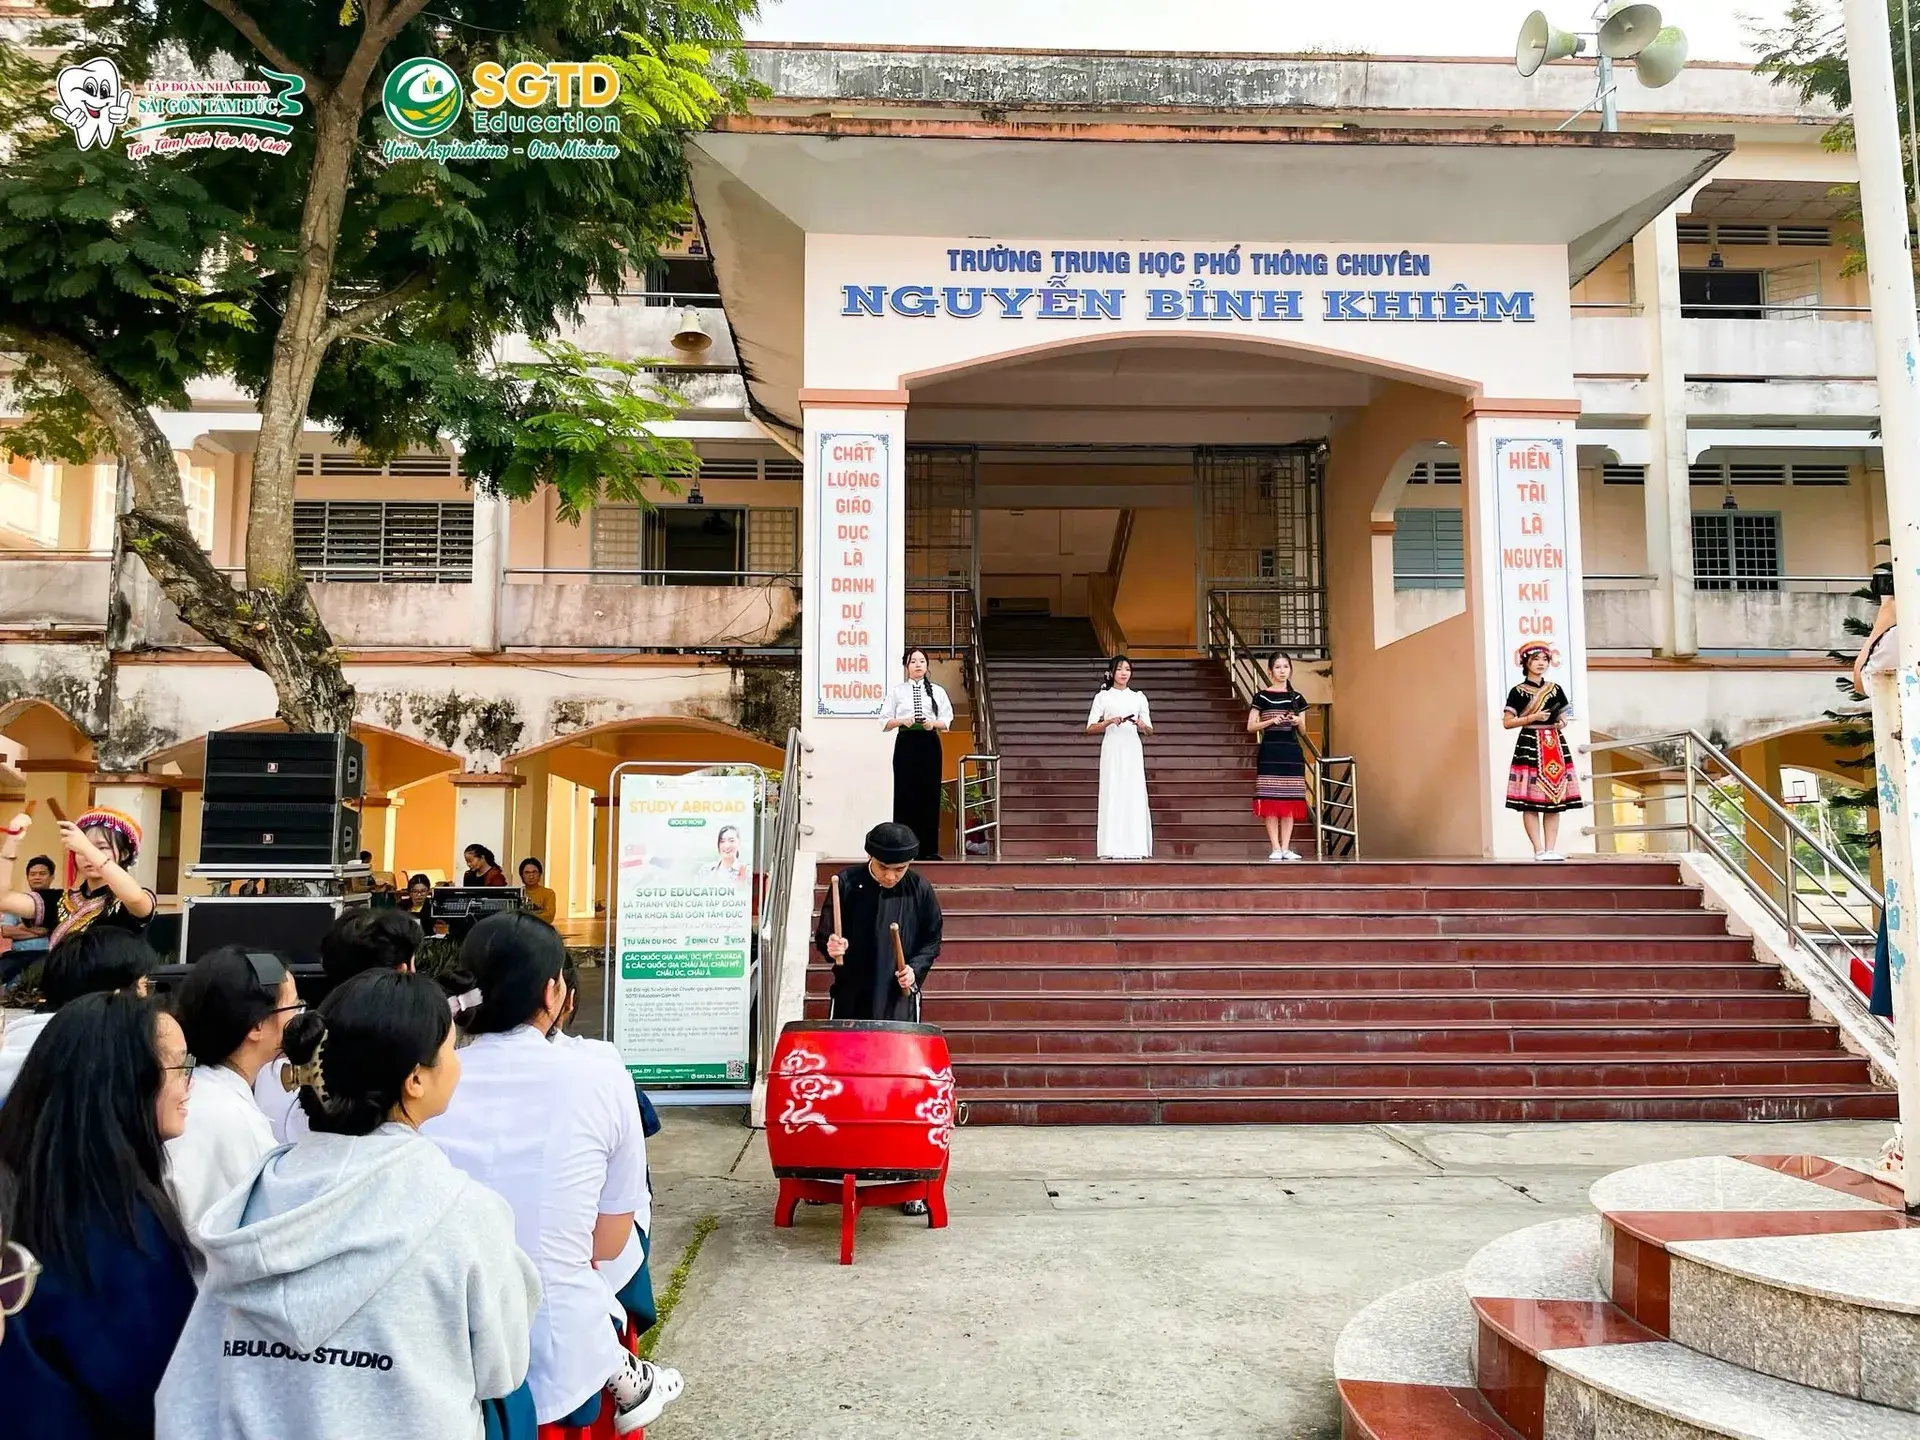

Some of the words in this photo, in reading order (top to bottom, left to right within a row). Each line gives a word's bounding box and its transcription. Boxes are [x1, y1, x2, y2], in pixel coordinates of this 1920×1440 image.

[947, 244, 1041, 272] TRƯỜNG
[1051, 250, 1130, 274] TRUNG
[1139, 251, 1185, 278] HỌC
[1250, 249, 1328, 276] THÔNG
[1336, 250, 1430, 276] CHUYÊN
[841, 275, 1126, 319] NGUYỄN
[1146, 279, 1304, 321] BỈNH
[1323, 283, 1535, 322] KHIÊM
[833, 441, 875, 462] CHẤT
[1509, 444, 1550, 469] HIỀN
[827, 470, 880, 491] LƯỢNG
[1517, 480, 1546, 502] TÀI
[835, 495, 872, 514] GIÁO
[837, 525, 869, 543] DỤC
[1521, 513, 1543, 534] LÀ
[843, 547, 863, 566] LÀ
[1503, 543, 1563, 569] NGUYÊN
[831, 578, 875, 593] DANH
[1518, 579, 1550, 602] KHÍ
[842, 602, 864, 622] DỰ
[1518, 608, 1554, 635] CỦA
[837, 624, 869, 646] CỦA
[836, 654, 869, 673] NHÀ
[822, 680, 883, 700] TRƯỜNG
[629, 800, 678, 813] STUDY
[681, 800, 746, 813] ABROAD
[636, 887, 667, 897] SGTD
[670, 887, 735, 897] EDUCATION
[625, 911, 643, 919] NHA
[645, 911, 668, 919] KHOA
[313, 1346, 393, 1371] STUDIO
